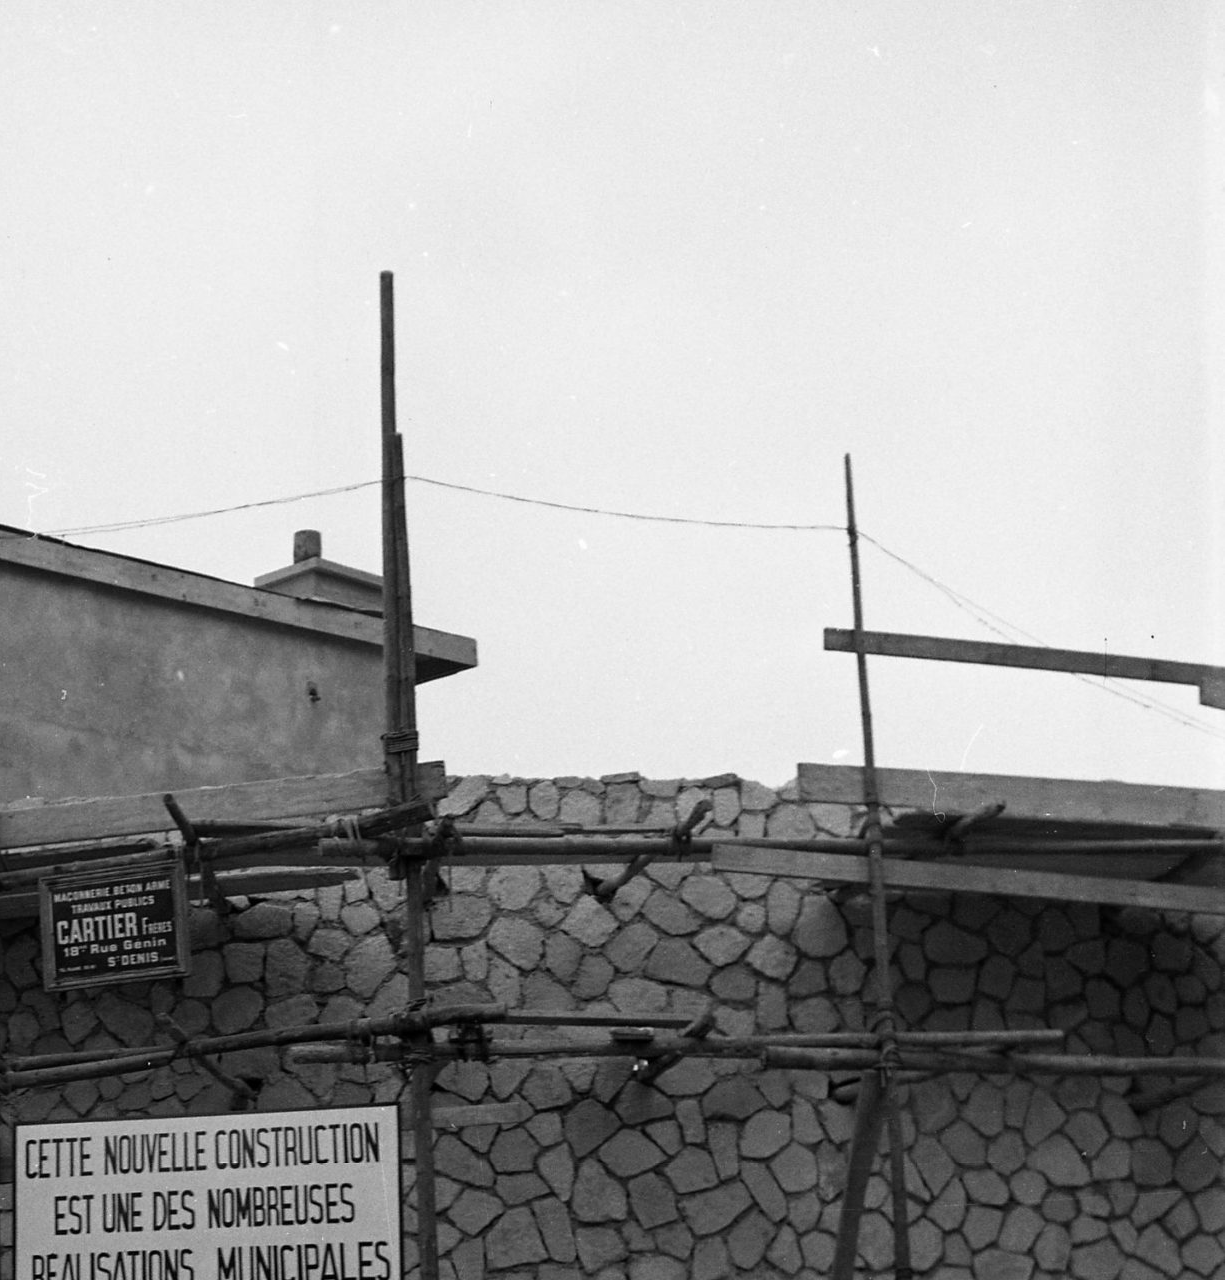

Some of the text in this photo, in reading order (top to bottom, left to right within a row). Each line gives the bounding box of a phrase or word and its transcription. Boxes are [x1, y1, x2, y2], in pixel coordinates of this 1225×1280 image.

[71, 895, 155, 914] TRAVAUX PUBLICS
[56, 912, 138, 945] CARTIER
[90, 944, 118, 955] Rue
[25, 1121, 380, 1179] CETTE NOUVELLE CONSTRUCTION
[53, 1182, 356, 1236] EST UNE DES NOMBREUSES
